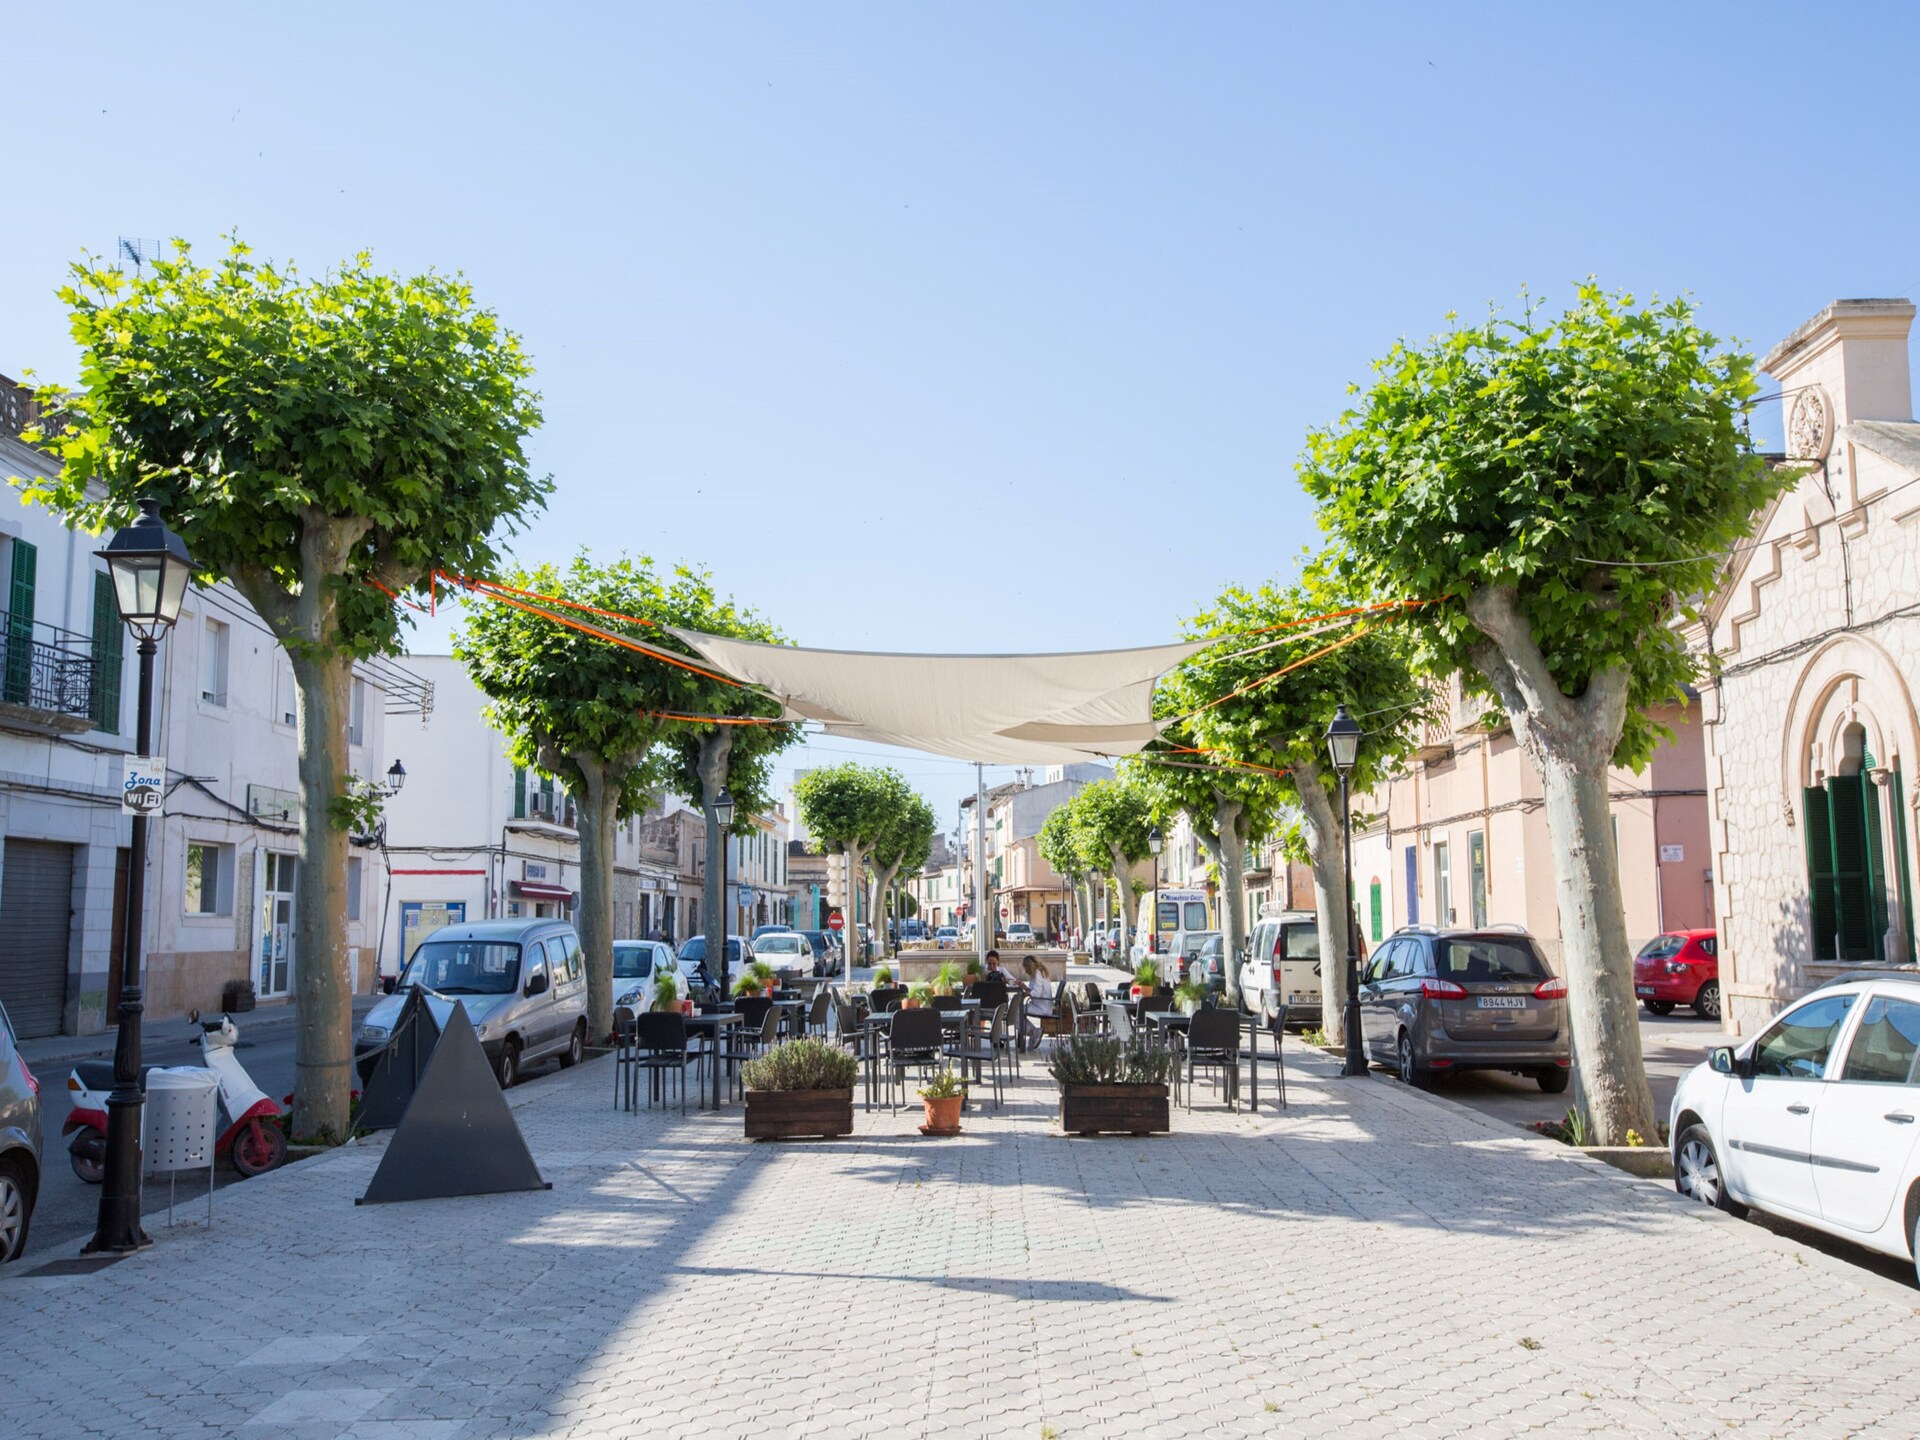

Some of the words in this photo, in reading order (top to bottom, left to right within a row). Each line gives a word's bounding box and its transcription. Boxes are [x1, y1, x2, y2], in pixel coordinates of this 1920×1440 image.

[125, 771, 161, 790] Zona
[1483, 998, 1505, 1007] 8944
[1507, 998, 1524, 1007] HJV
